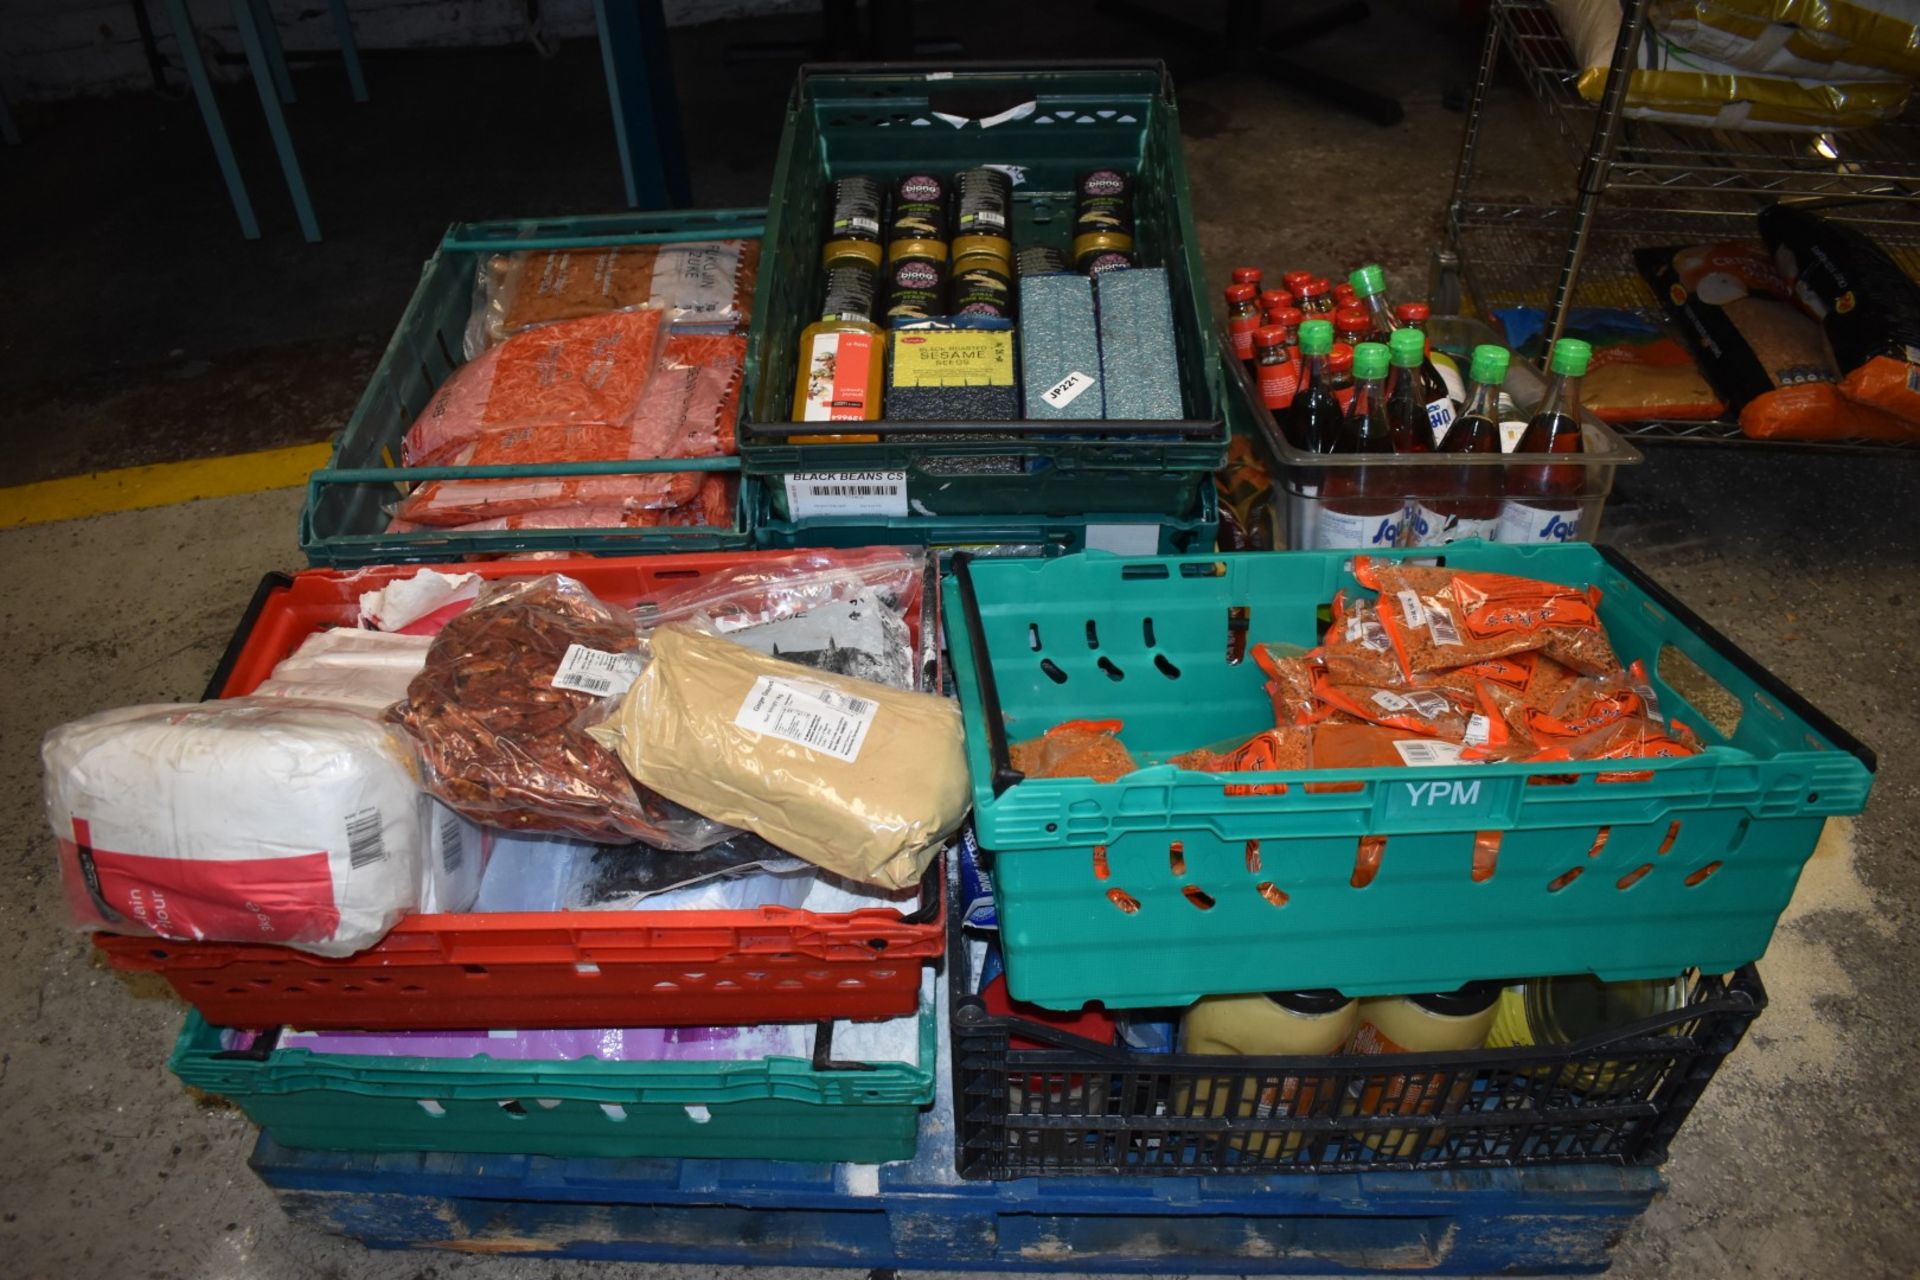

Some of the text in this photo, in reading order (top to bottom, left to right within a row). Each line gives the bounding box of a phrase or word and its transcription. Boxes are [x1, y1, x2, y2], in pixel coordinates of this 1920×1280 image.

[920, 351, 986, 360] SESAME
[1050, 376, 1079, 399] JP221
[793, 472, 904, 481] BLACK BEANS CS
[1406, 781, 1481, 806] YPM
